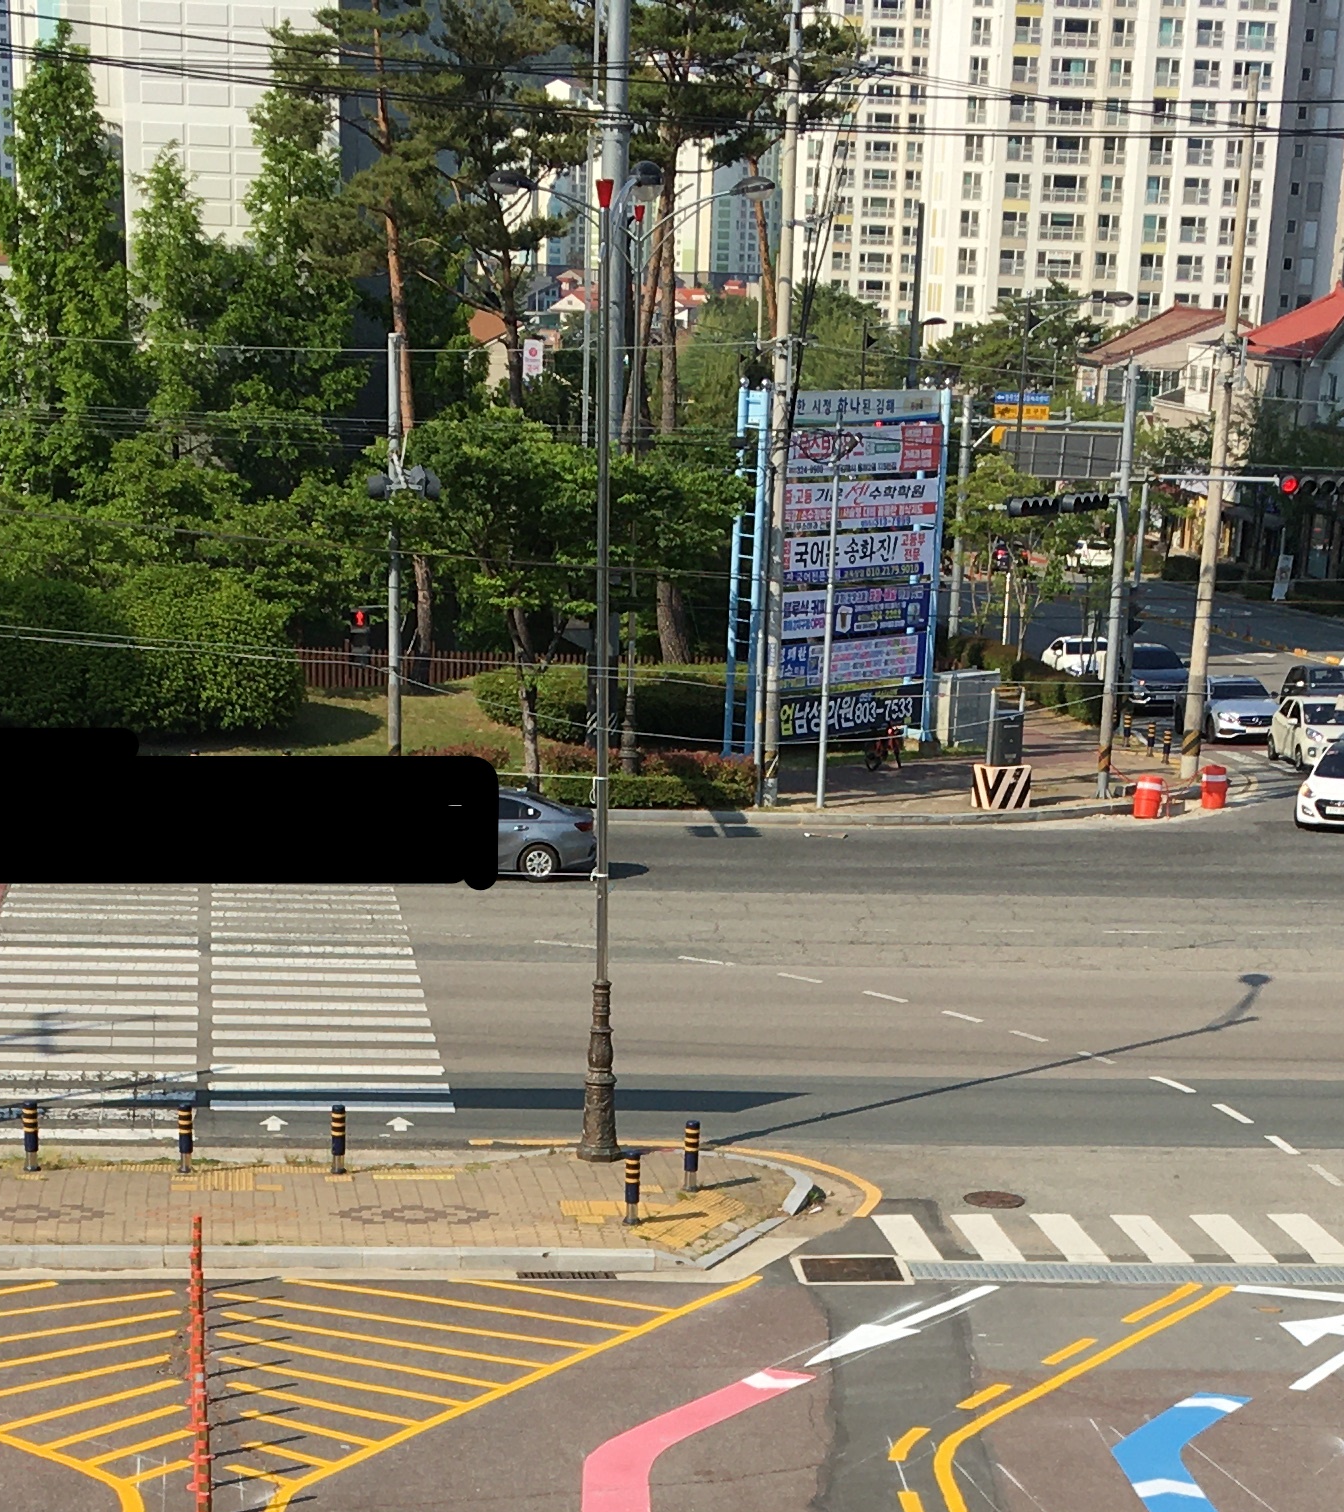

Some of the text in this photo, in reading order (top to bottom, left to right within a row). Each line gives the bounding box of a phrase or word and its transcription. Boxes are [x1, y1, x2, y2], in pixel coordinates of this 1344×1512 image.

[812, 399, 832, 415] 시정
[877, 398, 895, 414] 김해
[869, 485, 925, 499] 수학학원
[844, 535, 898, 565] 송화진!
[901, 532, 926, 546] 고등부
[904, 547, 921, 562] 전문
[795, 696, 856, 735] 남성의원
[855, 696, 913, 723] 803-7533
